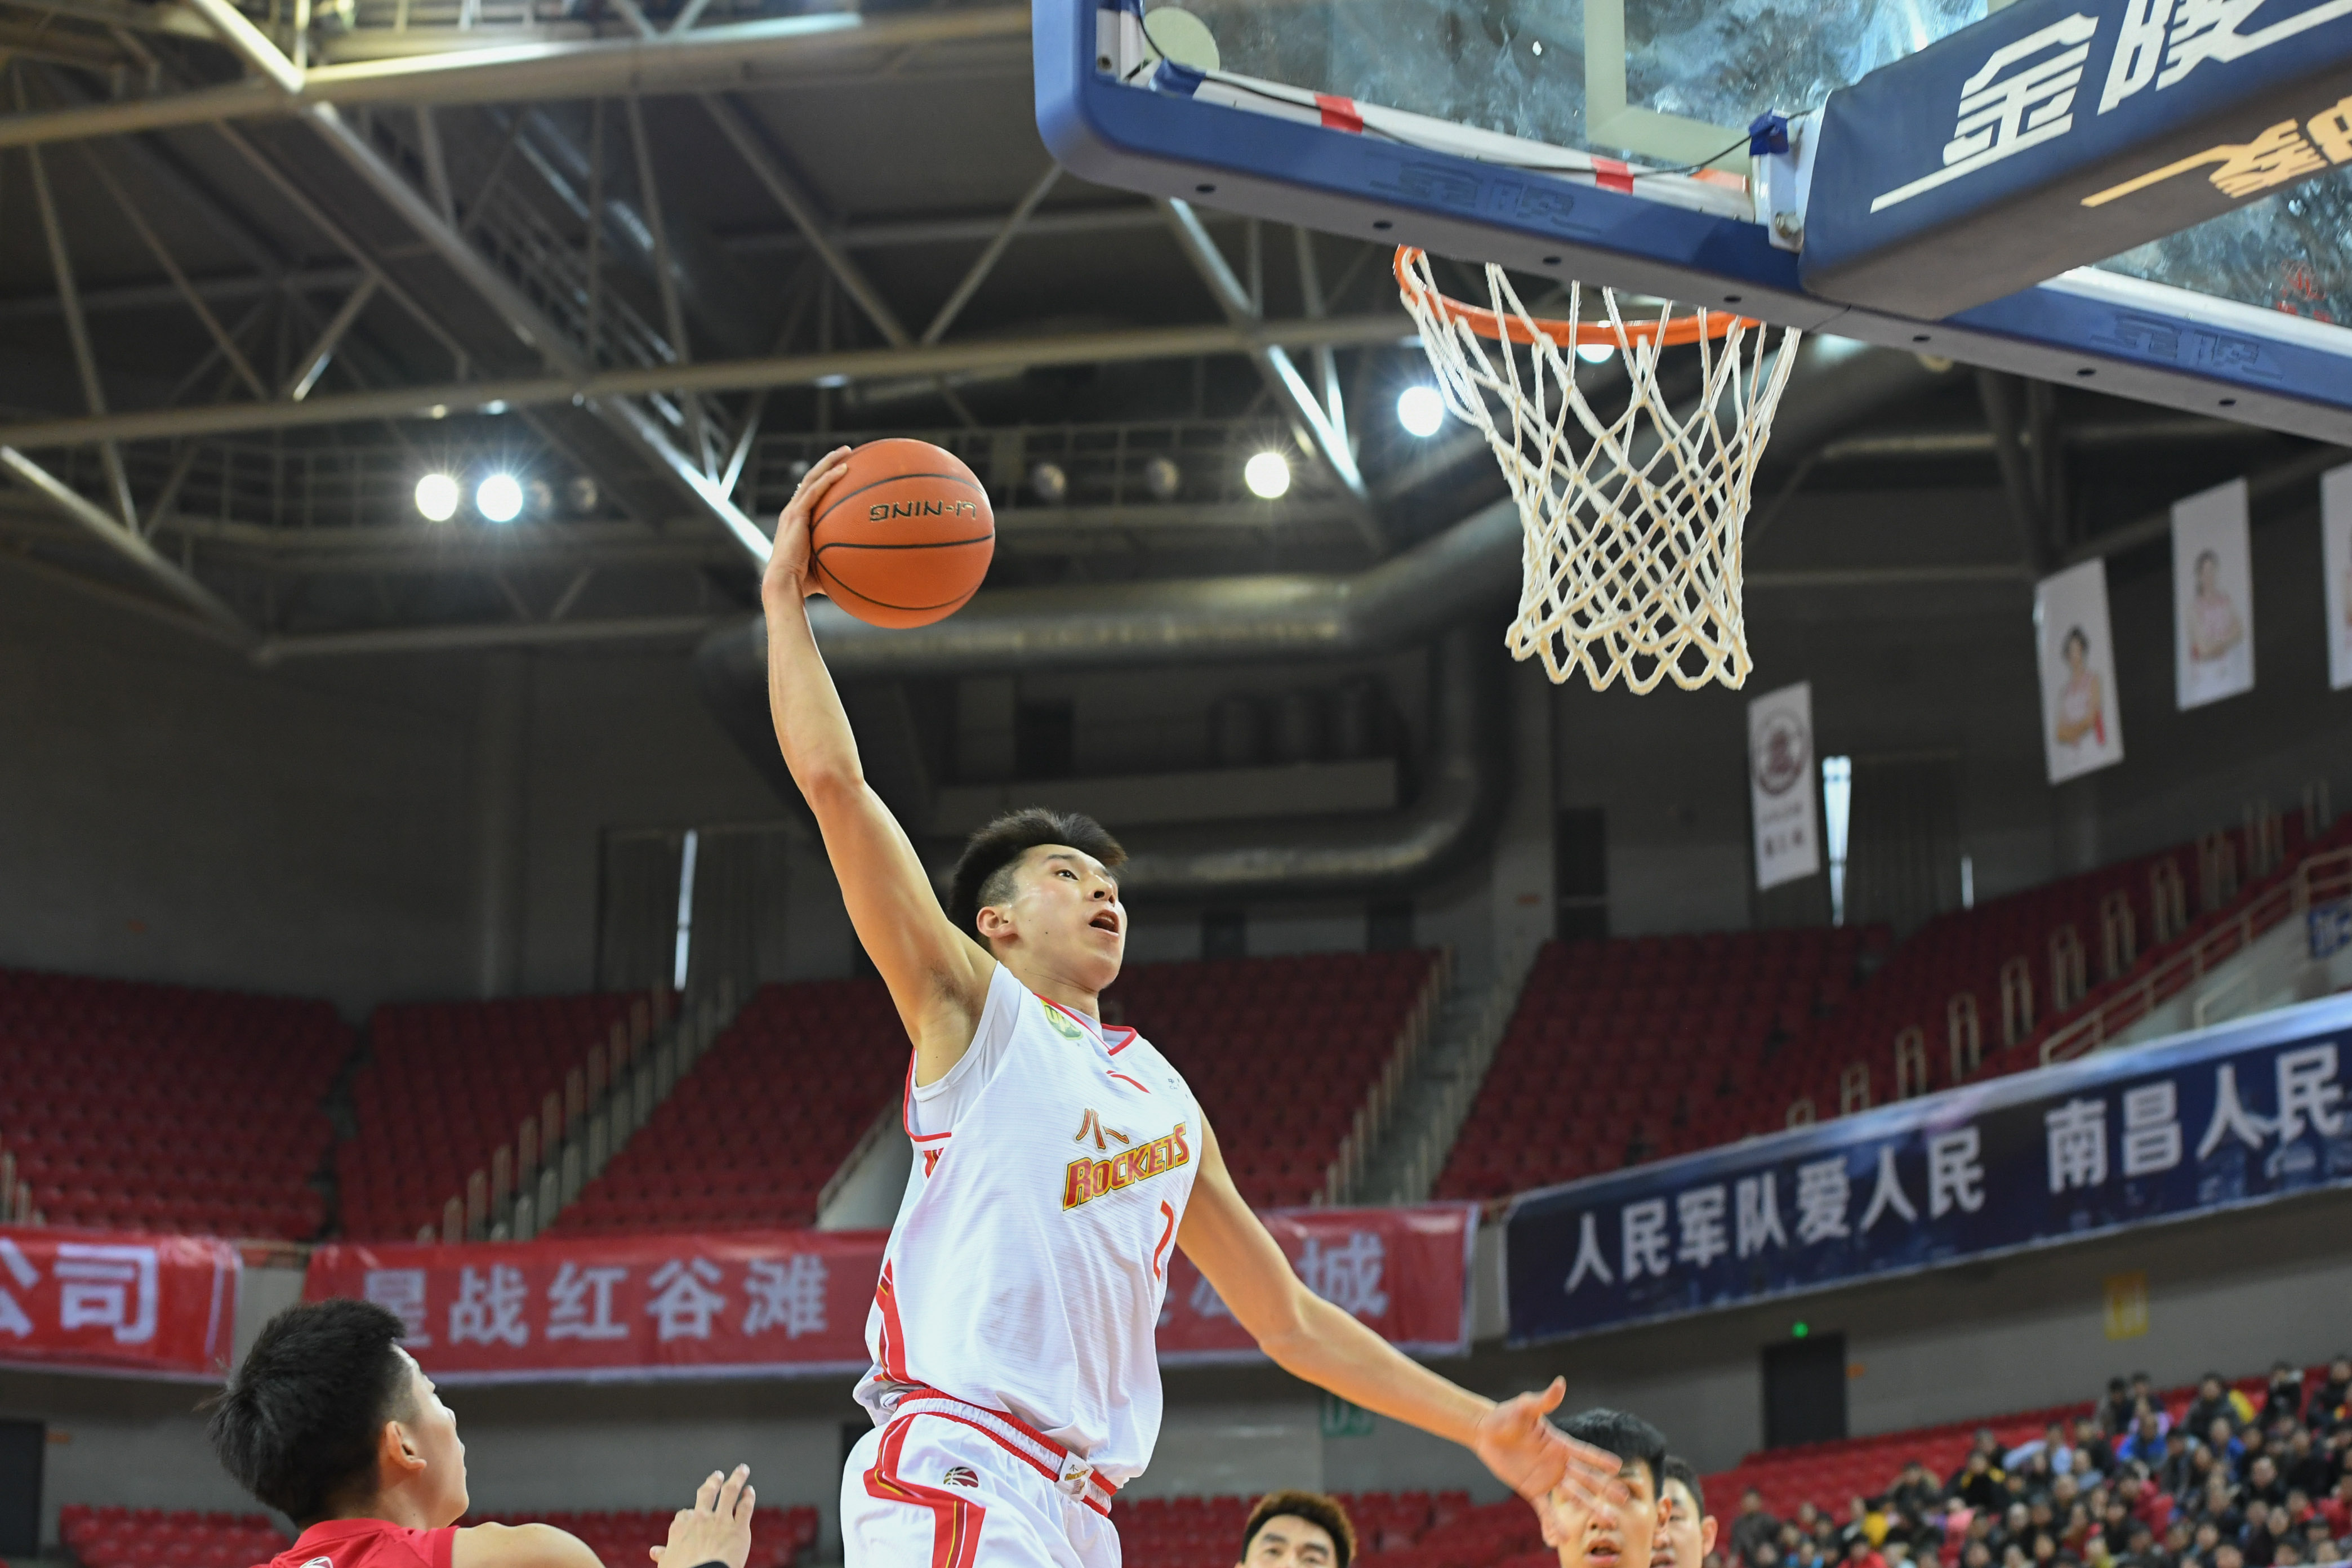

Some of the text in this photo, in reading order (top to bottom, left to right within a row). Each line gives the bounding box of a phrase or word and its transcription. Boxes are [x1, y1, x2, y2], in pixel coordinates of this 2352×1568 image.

[870, 500, 977, 522] LI-NING
[1062, 1121, 1190, 1211] ROCKETS
[1565, 1042, 2344, 1294] 人民军队爱人民 南昌人民
